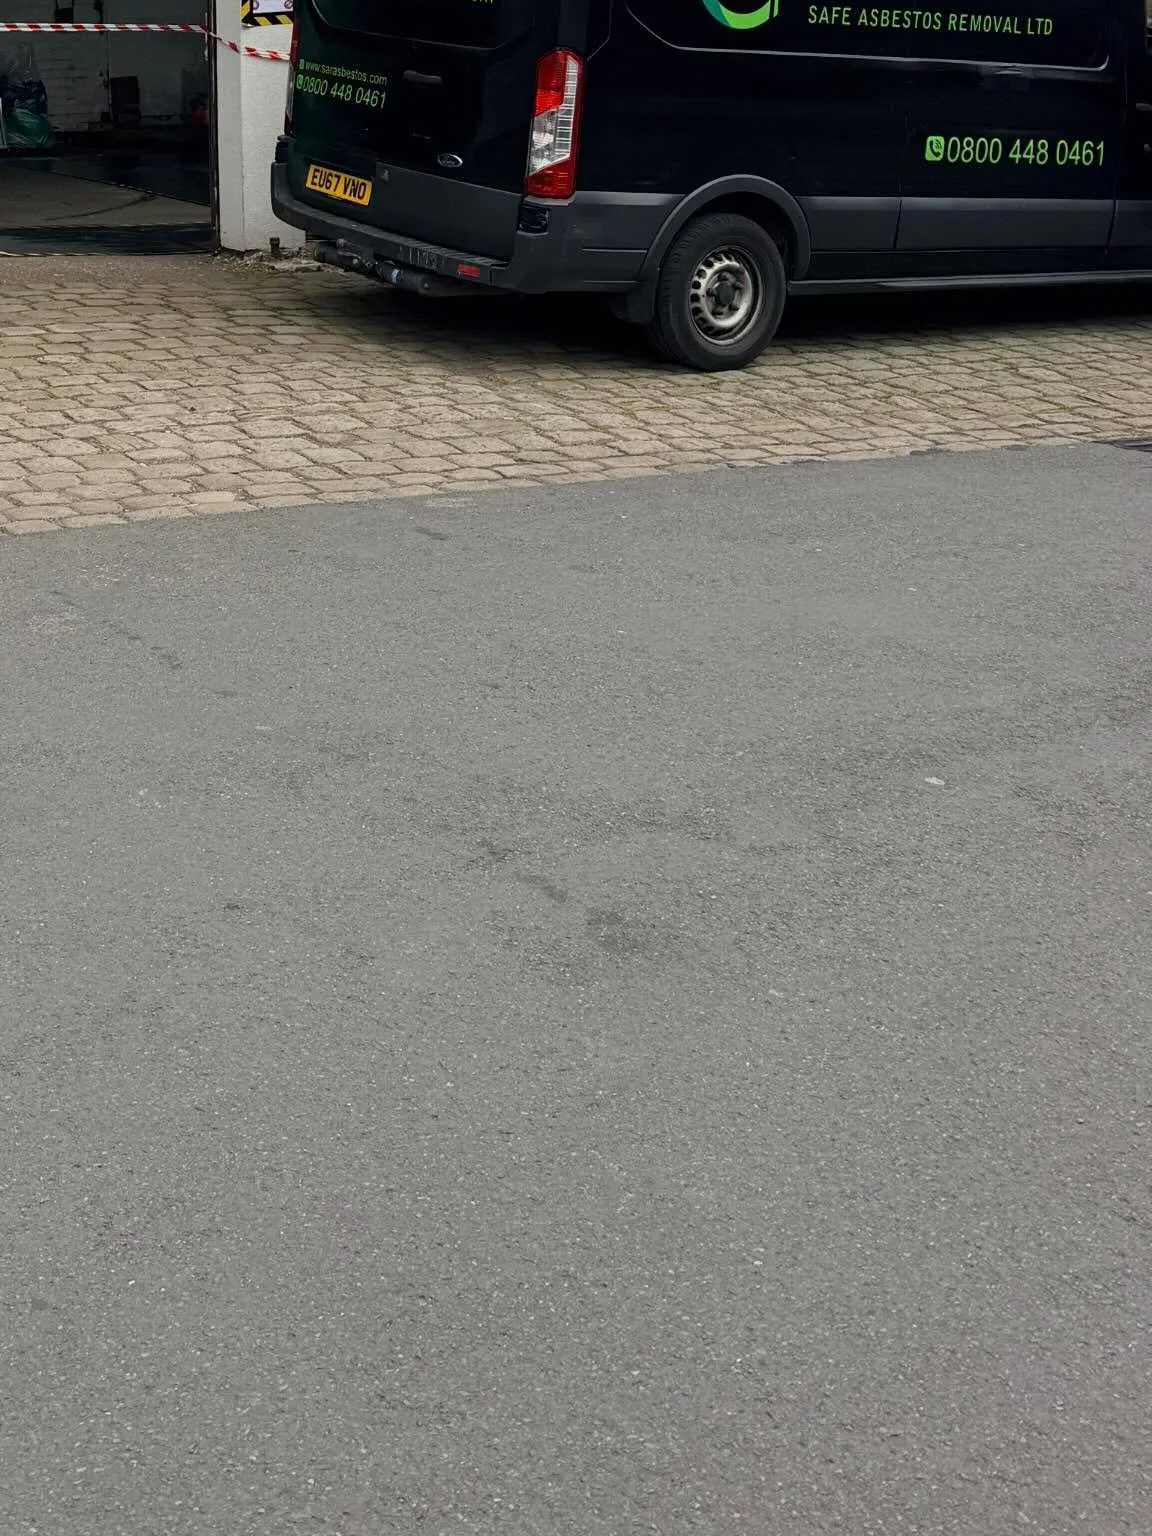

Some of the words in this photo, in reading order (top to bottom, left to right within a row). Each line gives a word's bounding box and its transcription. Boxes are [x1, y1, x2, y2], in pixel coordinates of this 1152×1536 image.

[808, 5, 852, 25] SAFE
[857, 8, 942, 30] ASBESTOS
[948, 13, 1022, 34] REMOVAL
[1027, 18, 1053, 36] LTD
[305, 62, 387, 86] www.sarasbestos.com
[302, 76, 328, 96] 0800
[330, 82, 353, 102] 448
[355, 87, 386, 109] 0461
[948, 136, 1002, 164] 0800
[1009, 138, 1048, 165] 448
[1056, 139, 1104, 166] 0461
[310, 168, 342, 193] EU67
[343, 176, 367, 200] VNO
